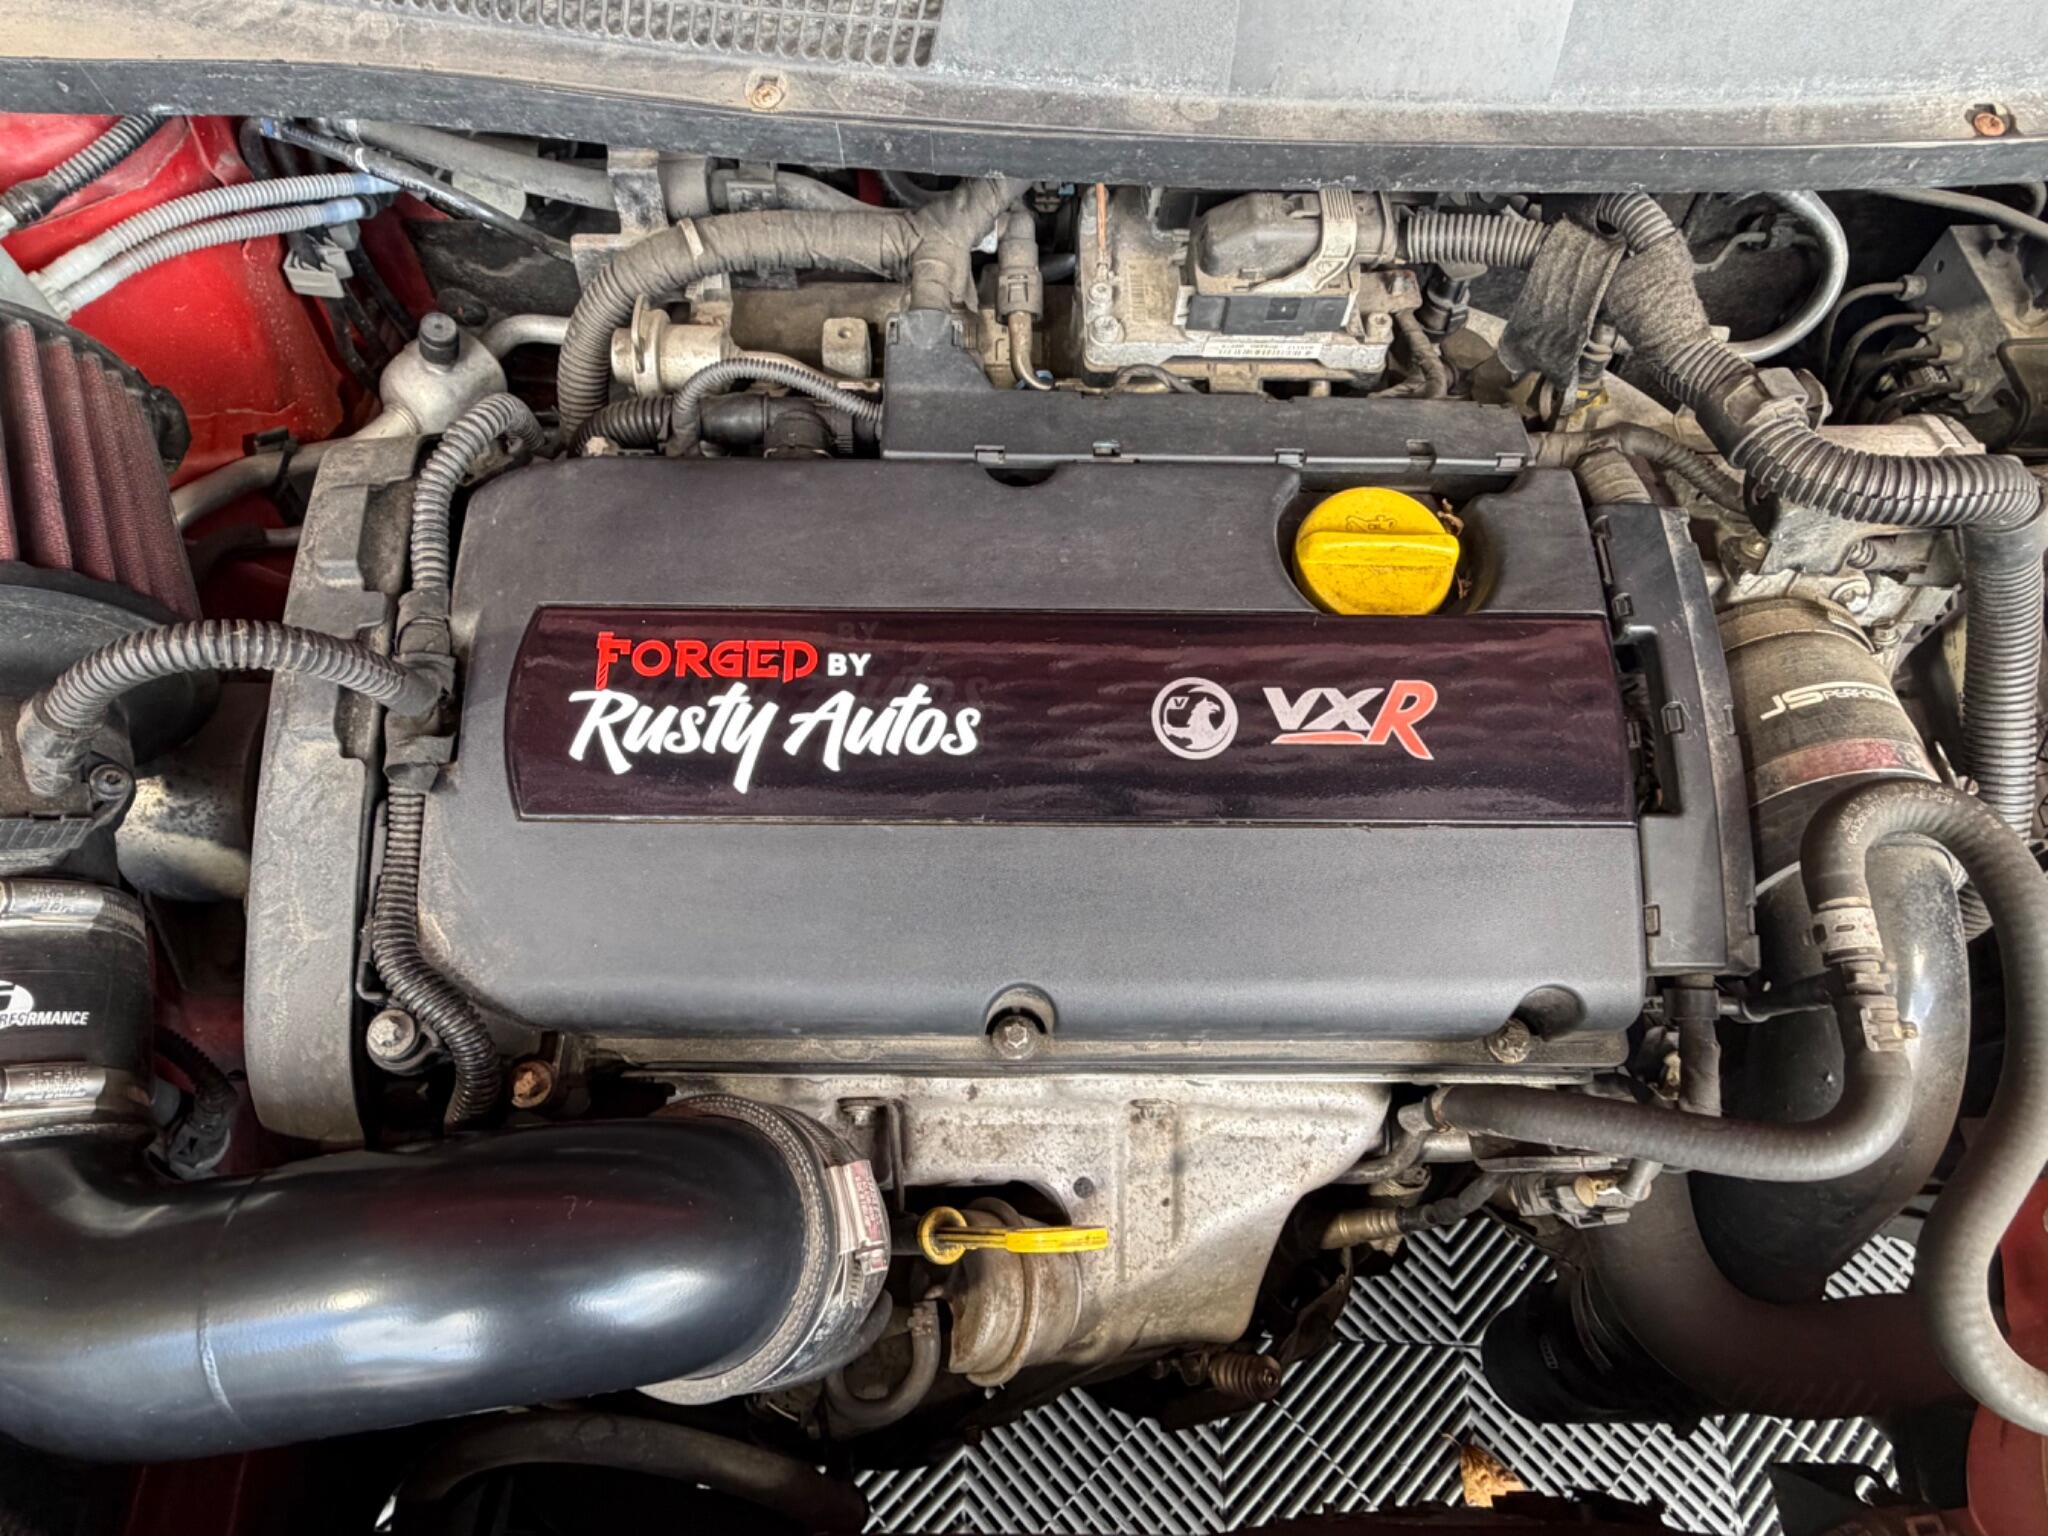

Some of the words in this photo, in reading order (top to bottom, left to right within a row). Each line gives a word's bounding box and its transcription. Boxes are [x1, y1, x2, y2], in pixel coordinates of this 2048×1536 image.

[596, 631, 818, 690] FORGED
[827, 653, 872, 677] BY
[568, 681, 780, 794] Rusty
[783, 683, 982, 772] Autos
[1262, 679, 1438, 760] VXR
[0, 1010, 90, 1027] RFORMANCE
